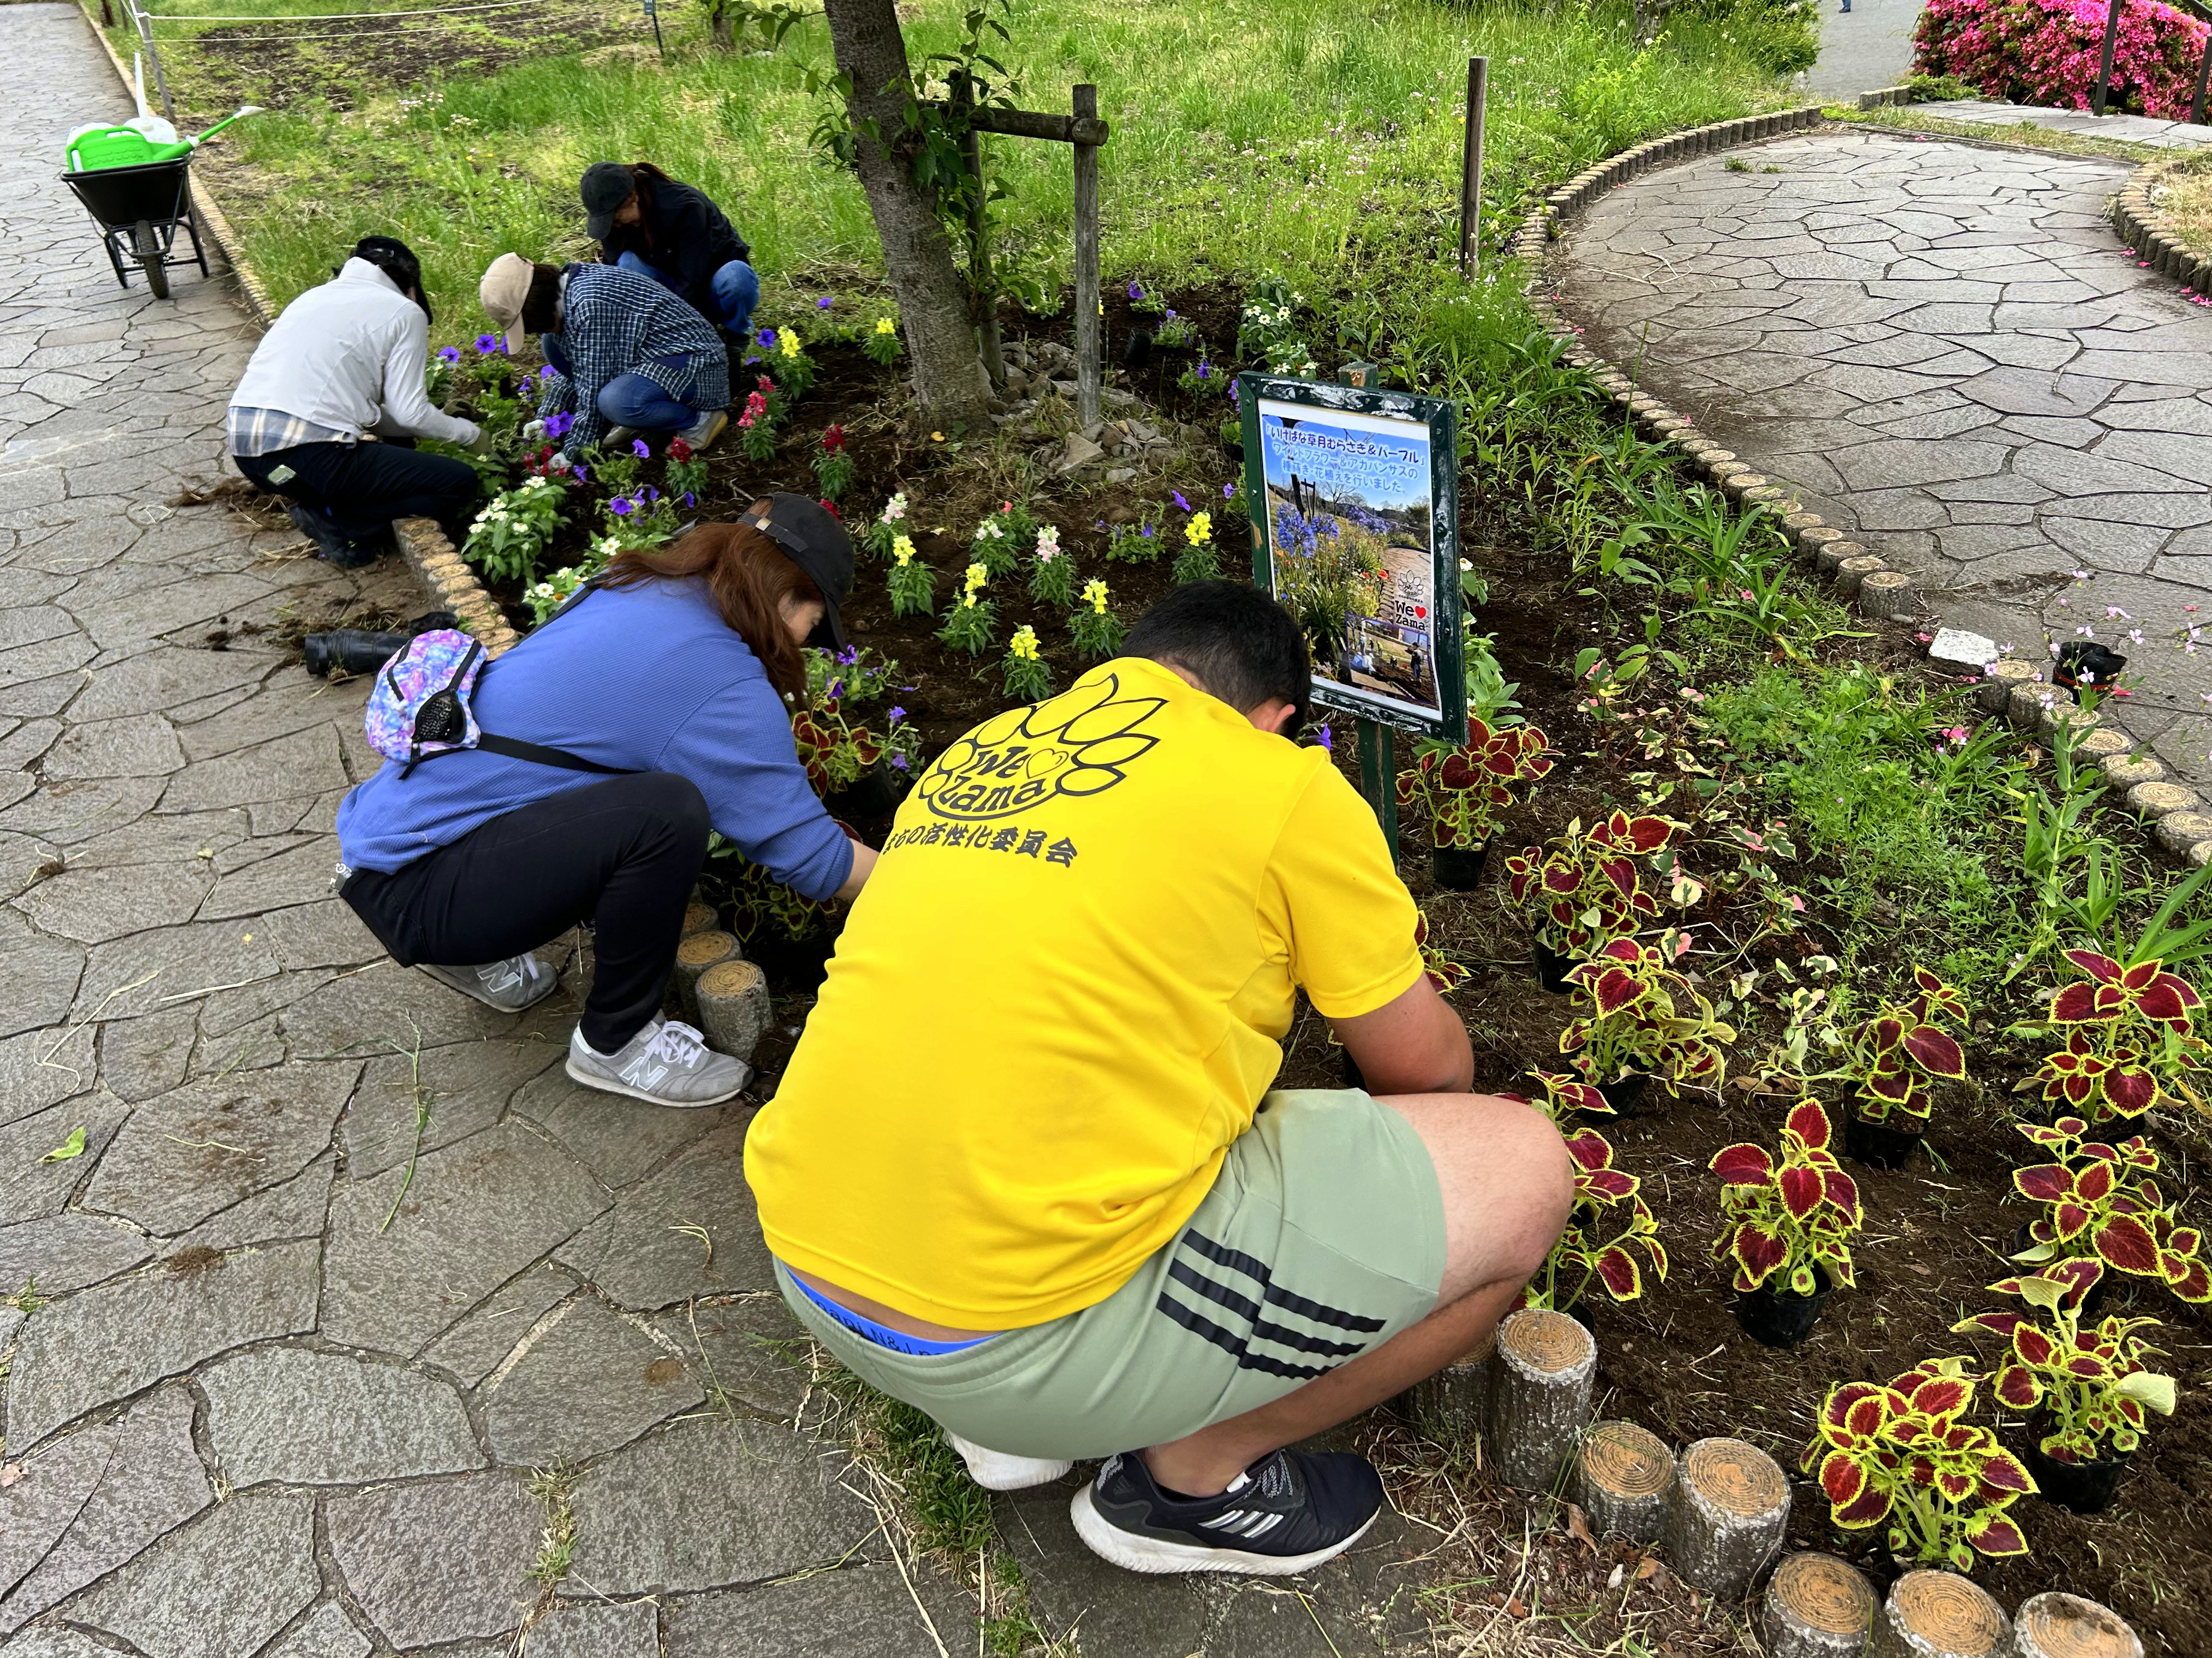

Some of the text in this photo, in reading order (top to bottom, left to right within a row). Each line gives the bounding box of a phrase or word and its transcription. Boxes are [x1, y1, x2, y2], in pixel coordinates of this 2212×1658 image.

[1395, 600, 1414, 616] We
[1396, 614, 1426, 631] Zama
[960, 747, 1031, 778] We
[938, 775, 1047, 812] Zama
[620, 1056, 668, 1091] N
